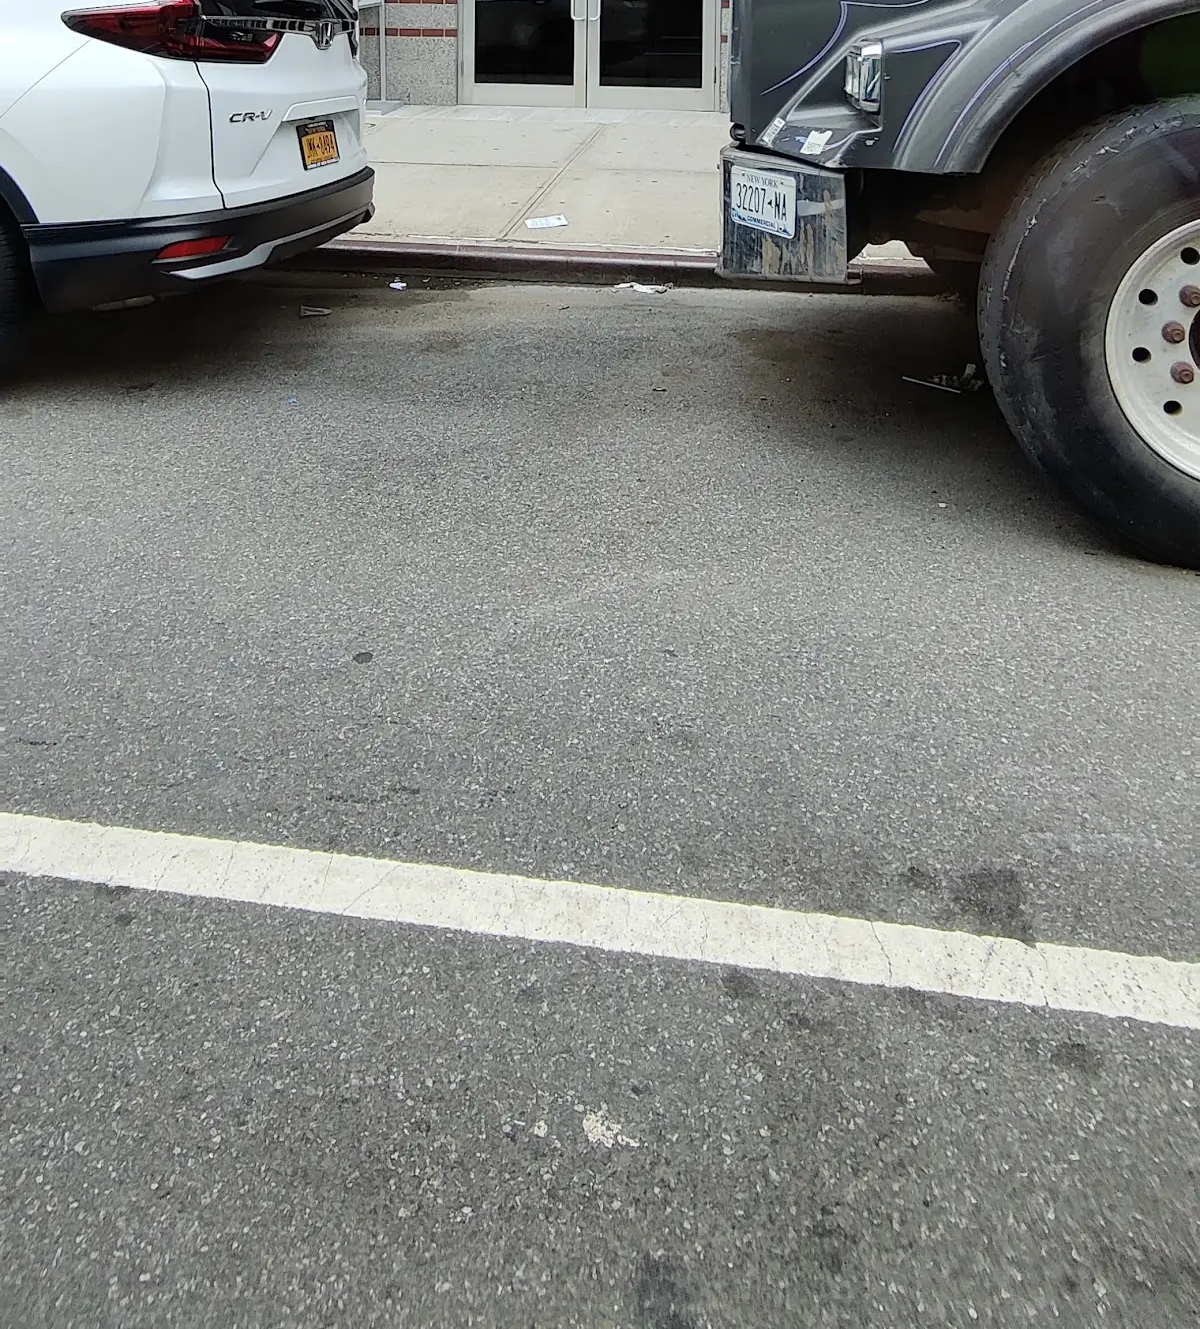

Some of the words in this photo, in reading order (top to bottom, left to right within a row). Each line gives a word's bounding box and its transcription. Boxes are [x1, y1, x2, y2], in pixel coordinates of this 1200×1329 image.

[229, 109, 273, 123] CR-V
[746, 174, 760, 184] NEW
[761, 177, 778, 188] YORK
